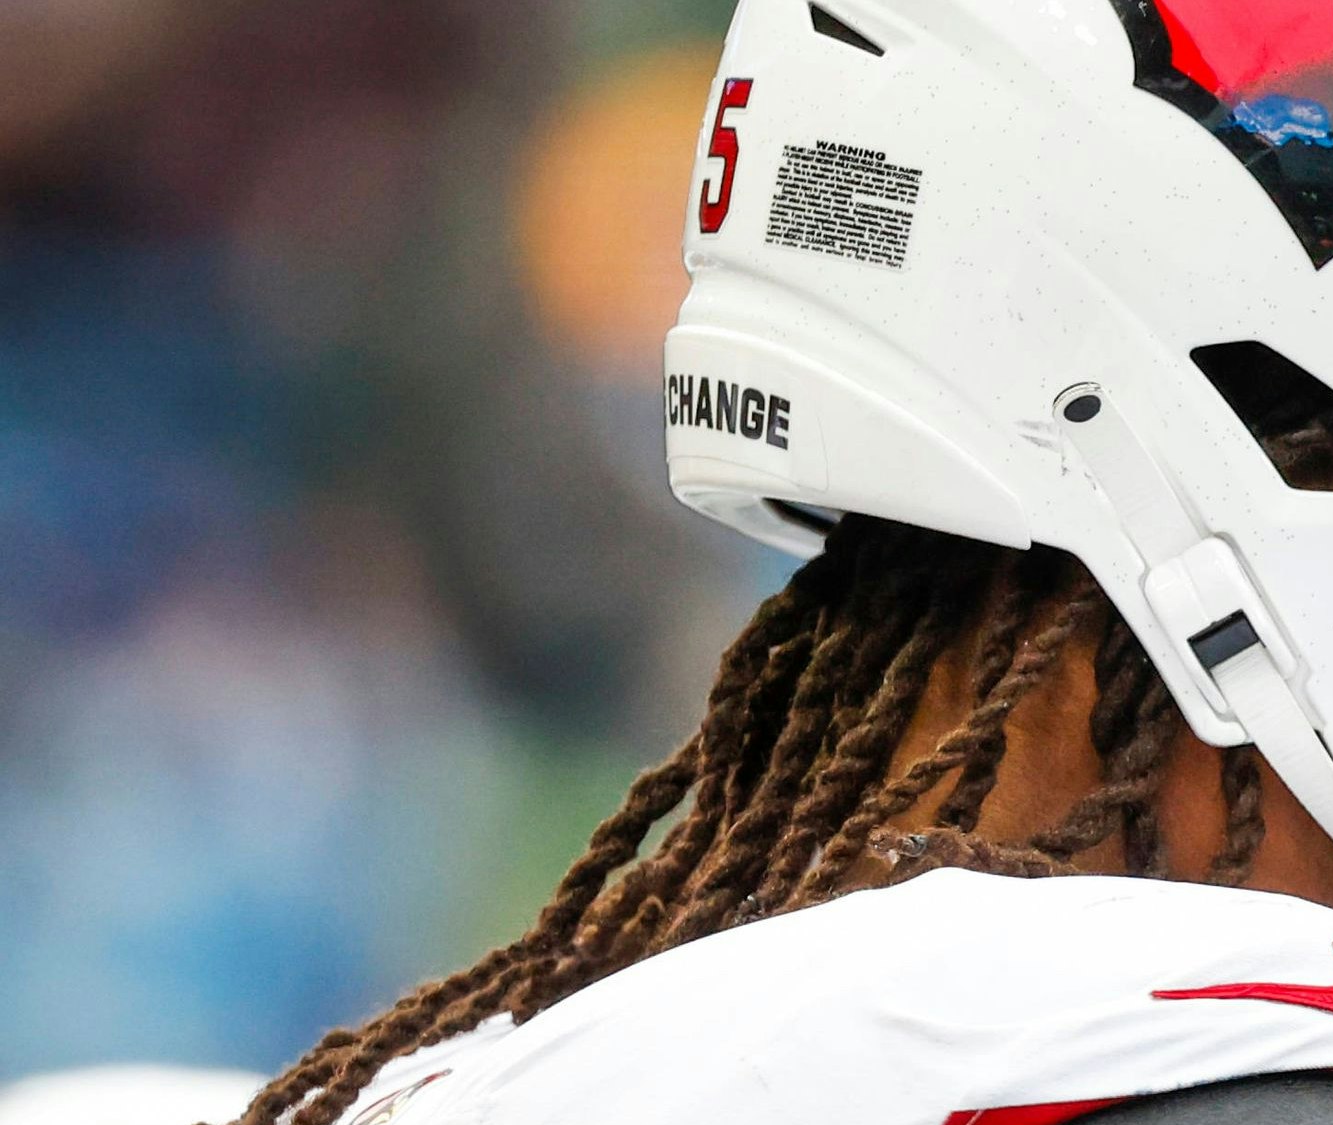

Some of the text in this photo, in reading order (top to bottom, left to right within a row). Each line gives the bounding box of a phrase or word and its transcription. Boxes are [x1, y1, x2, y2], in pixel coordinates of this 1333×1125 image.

[699, 78, 754, 233] 5
[816, 140, 886, 161] WARNING
[668, 374, 791, 451] CHANGE
